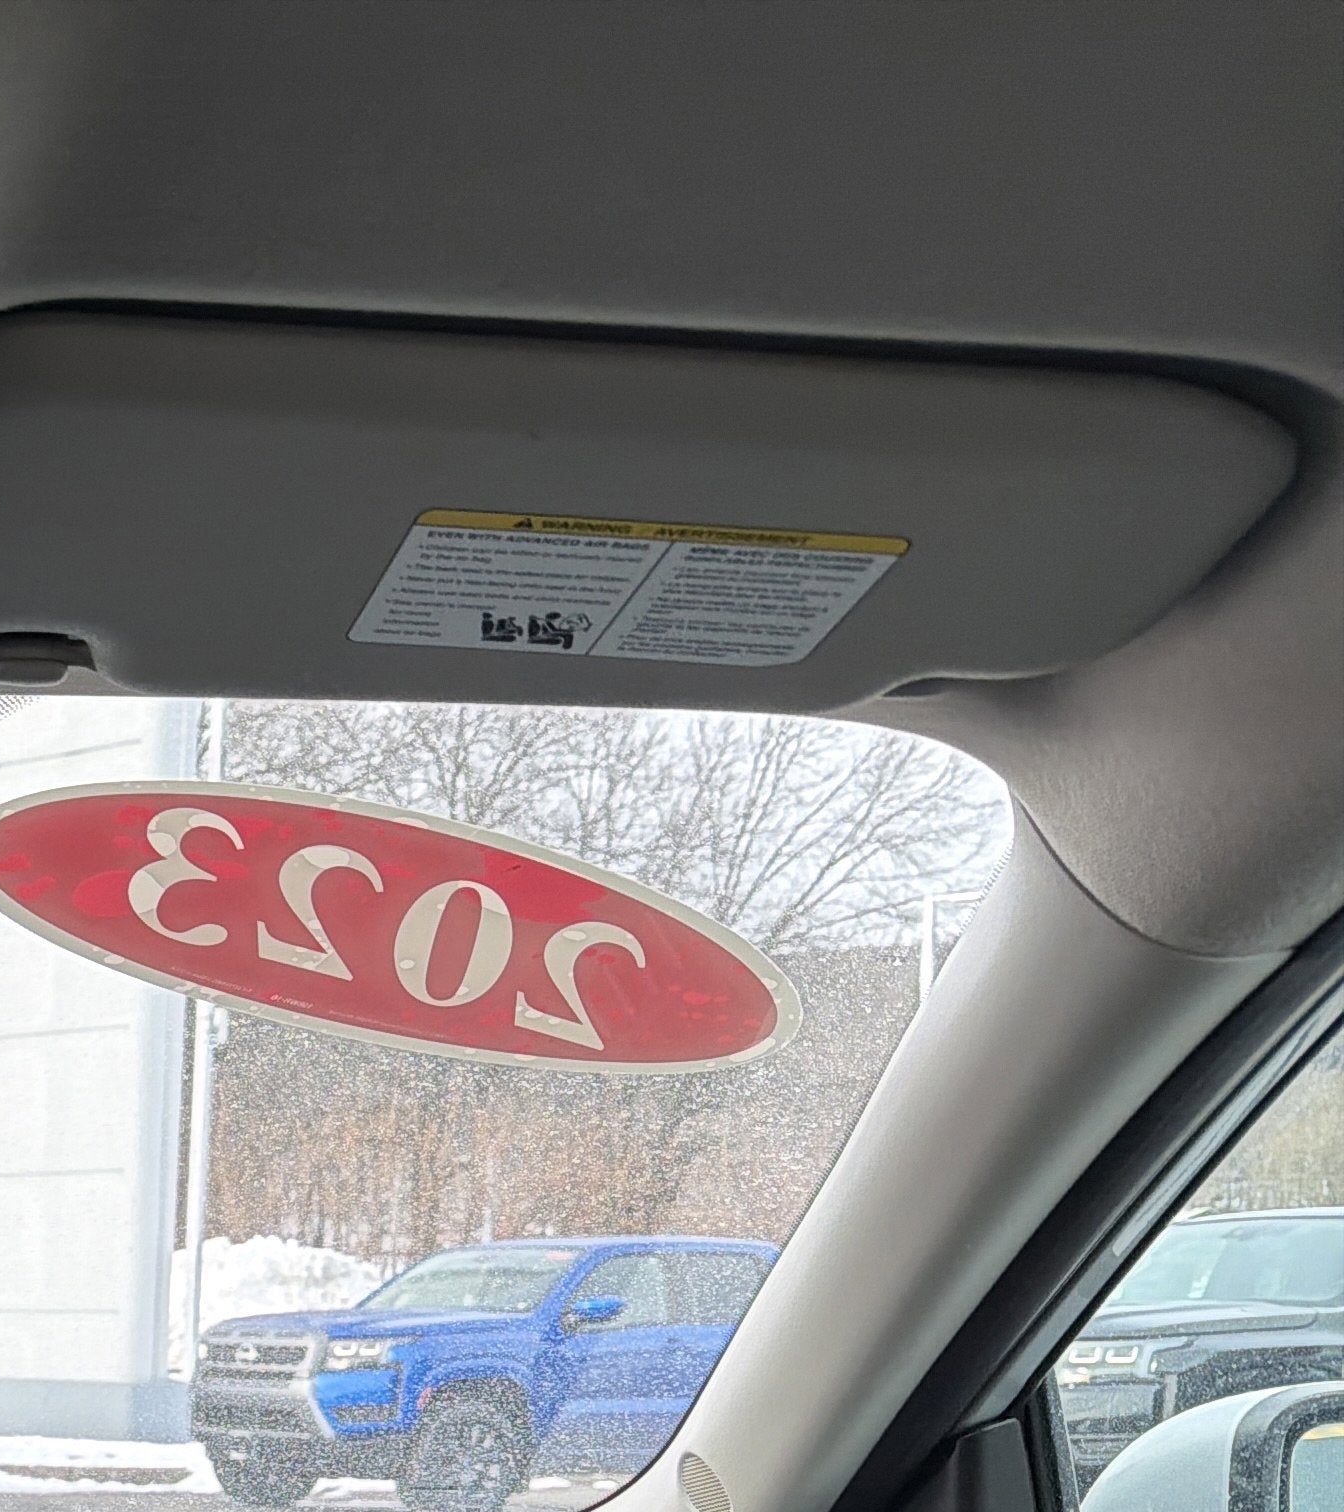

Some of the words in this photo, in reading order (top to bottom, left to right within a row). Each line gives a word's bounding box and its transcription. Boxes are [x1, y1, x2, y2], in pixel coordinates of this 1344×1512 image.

[427, 530, 463, 540] EVEN
[467, 532, 502, 542] WITH
[506, 535, 581, 547] ADVANCED
[584, 539, 608, 548] AIR
